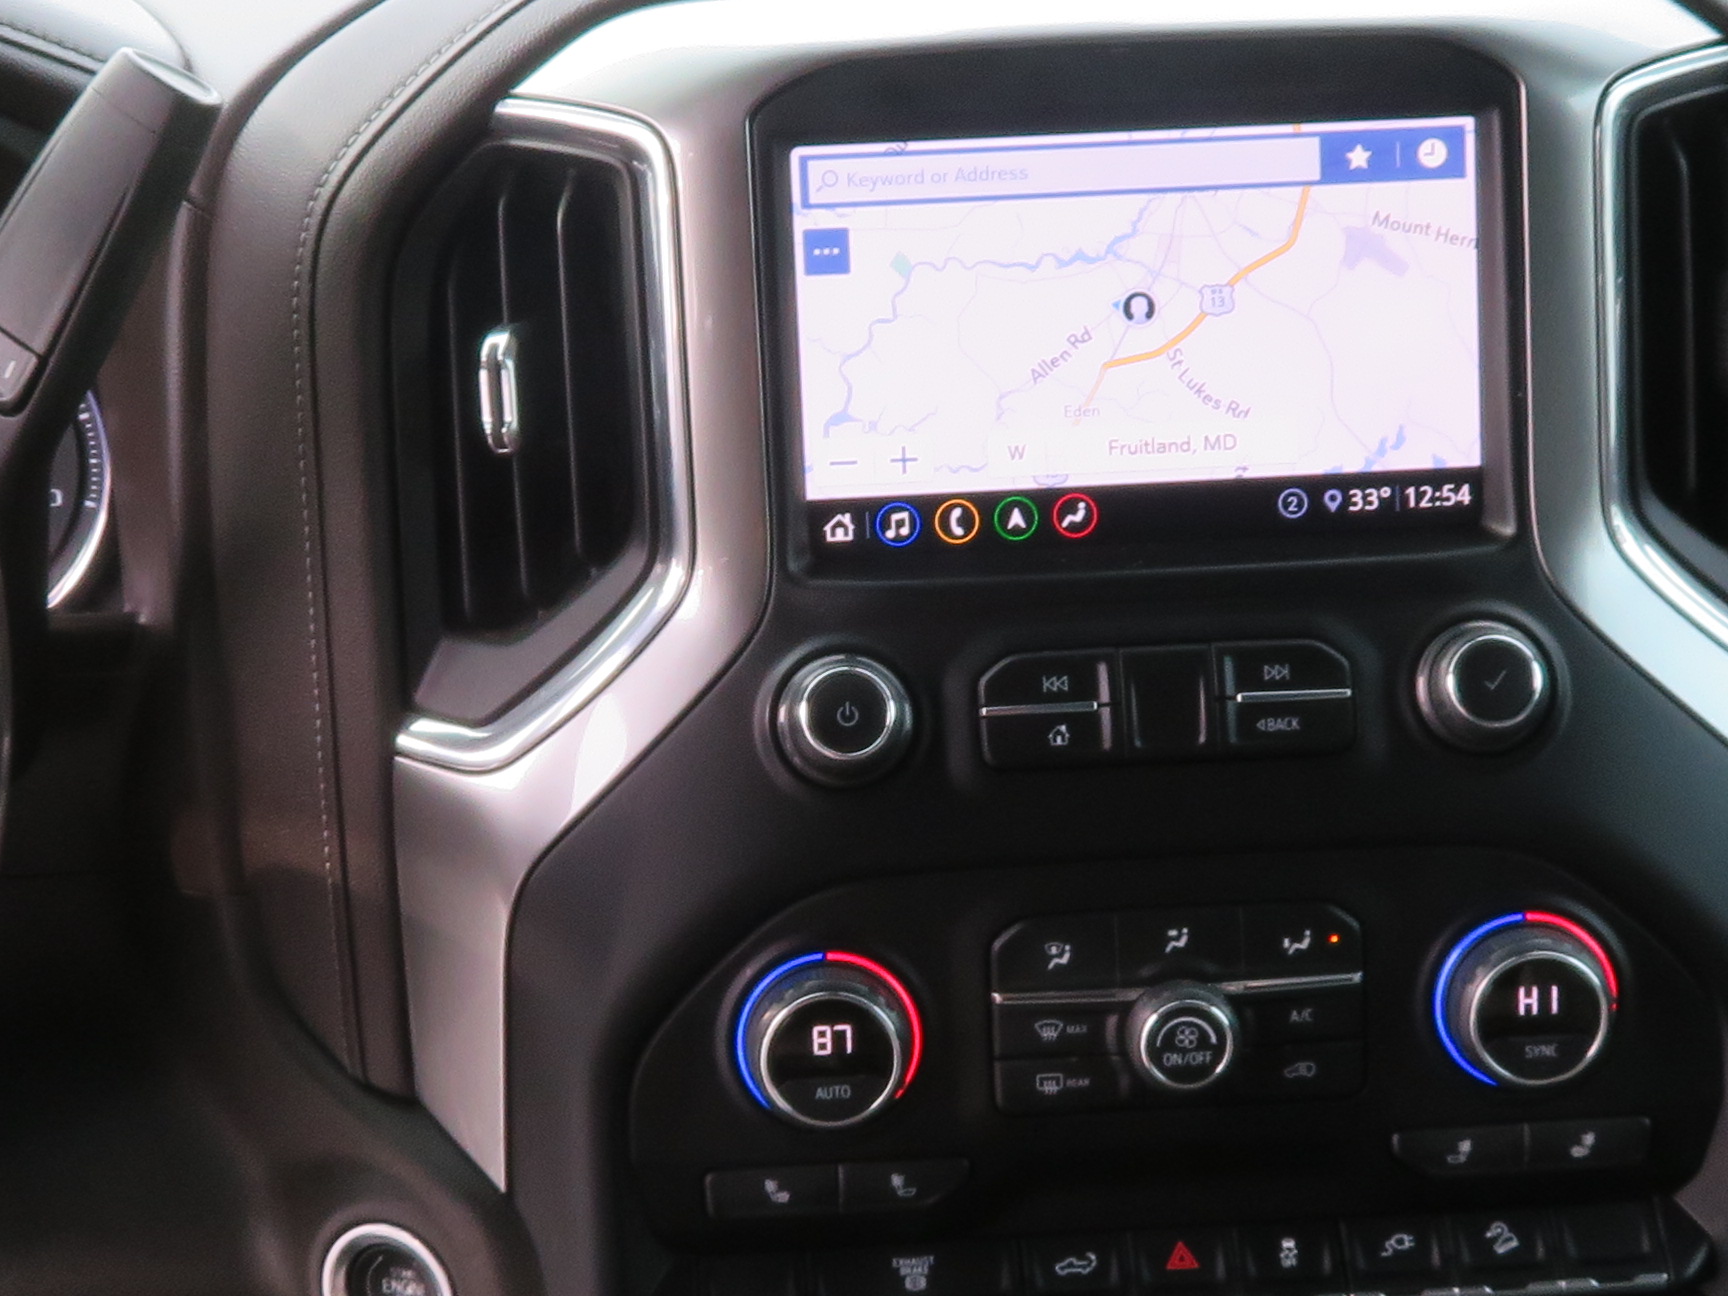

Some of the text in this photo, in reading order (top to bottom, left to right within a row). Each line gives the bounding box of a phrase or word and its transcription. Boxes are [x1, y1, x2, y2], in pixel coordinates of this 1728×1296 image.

[846, 165, 1030, 192] Keyword or Address
[1372, 209, 1431, 237] Mount
[1029, 326, 1093, 384] Allen Rd
[1166, 347, 1185, 370] St
[1177, 368, 1223, 410] Lukes
[1063, 404, 1101, 418] Eden
[1007, 444, 1027, 461] W
[1108, 433, 1238, 456] Fruitland, MD
[1287, 482, 1472, 512] 2 33° 12:54
[1267, 717, 1300, 731] BACK
[1518, 984, 1559, 1016] HI
[1289, 1008, 1313, 1023] A/C
[812, 1024, 852, 1056] 87
[1162, 1050, 1213, 1068] ON/OFF
[815, 1084, 852, 1100] AUTO
